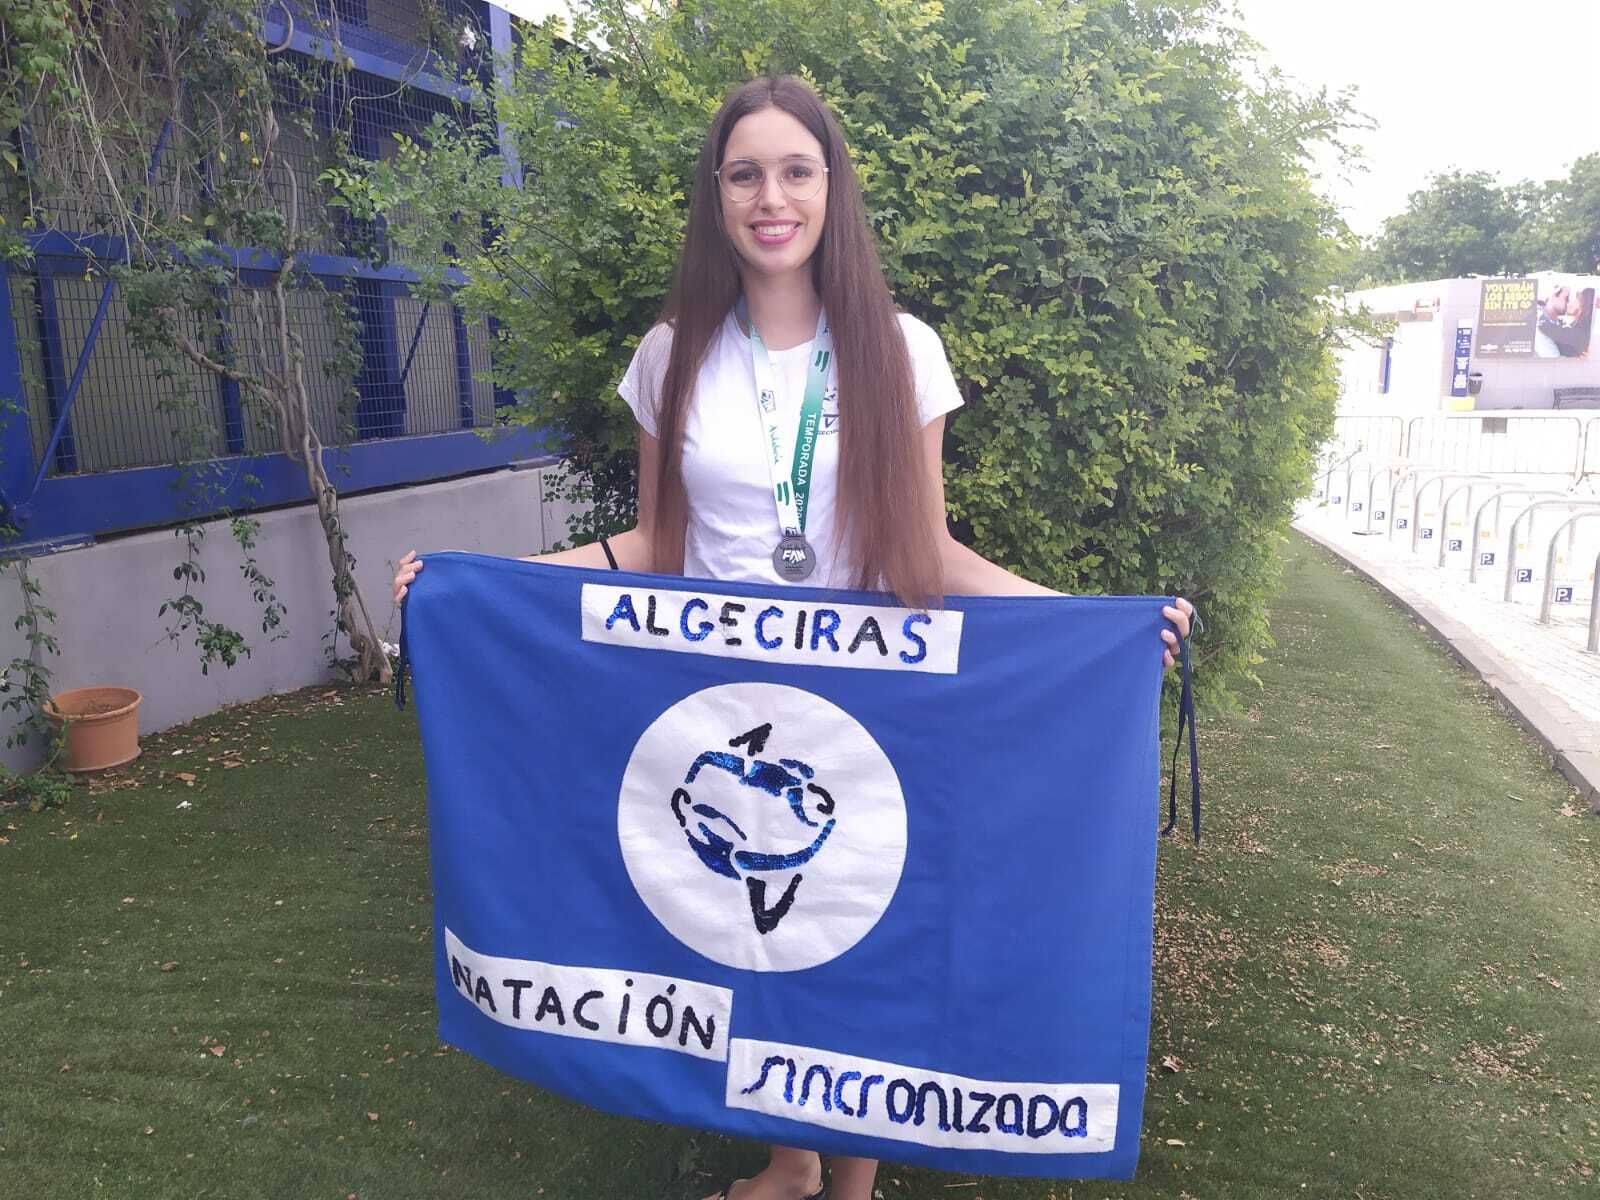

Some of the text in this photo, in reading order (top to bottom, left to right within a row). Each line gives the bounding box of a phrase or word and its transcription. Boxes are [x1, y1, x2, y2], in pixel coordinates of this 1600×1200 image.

[796, 412, 817, 486] TEMPORADA
[605, 594, 932, 664] ALGECIRAS
[451, 955, 715, 1049] NATACIÓN
